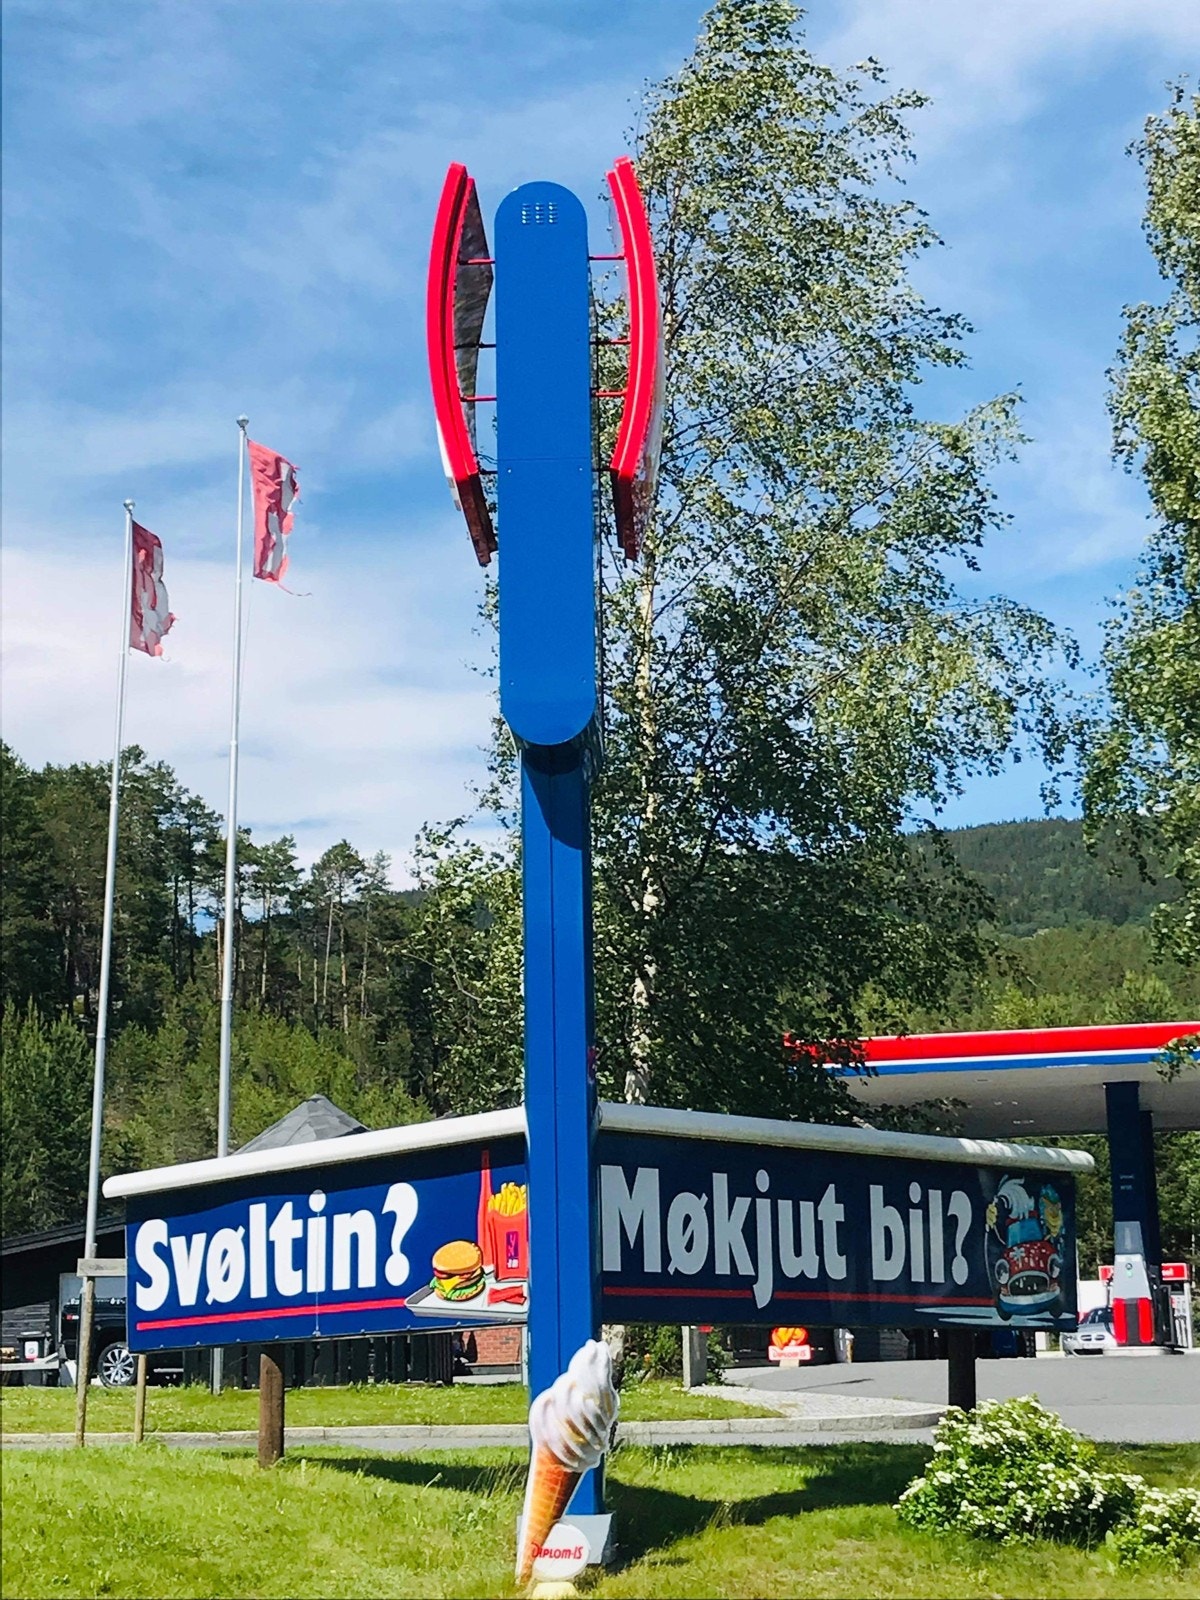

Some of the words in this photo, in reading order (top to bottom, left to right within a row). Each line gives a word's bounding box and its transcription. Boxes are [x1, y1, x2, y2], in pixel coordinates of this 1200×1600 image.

[135, 1182, 419, 1311] Svøltin?
[600, 1164, 847, 1309] Møkjut
[869, 1181, 972, 1286] bil?
